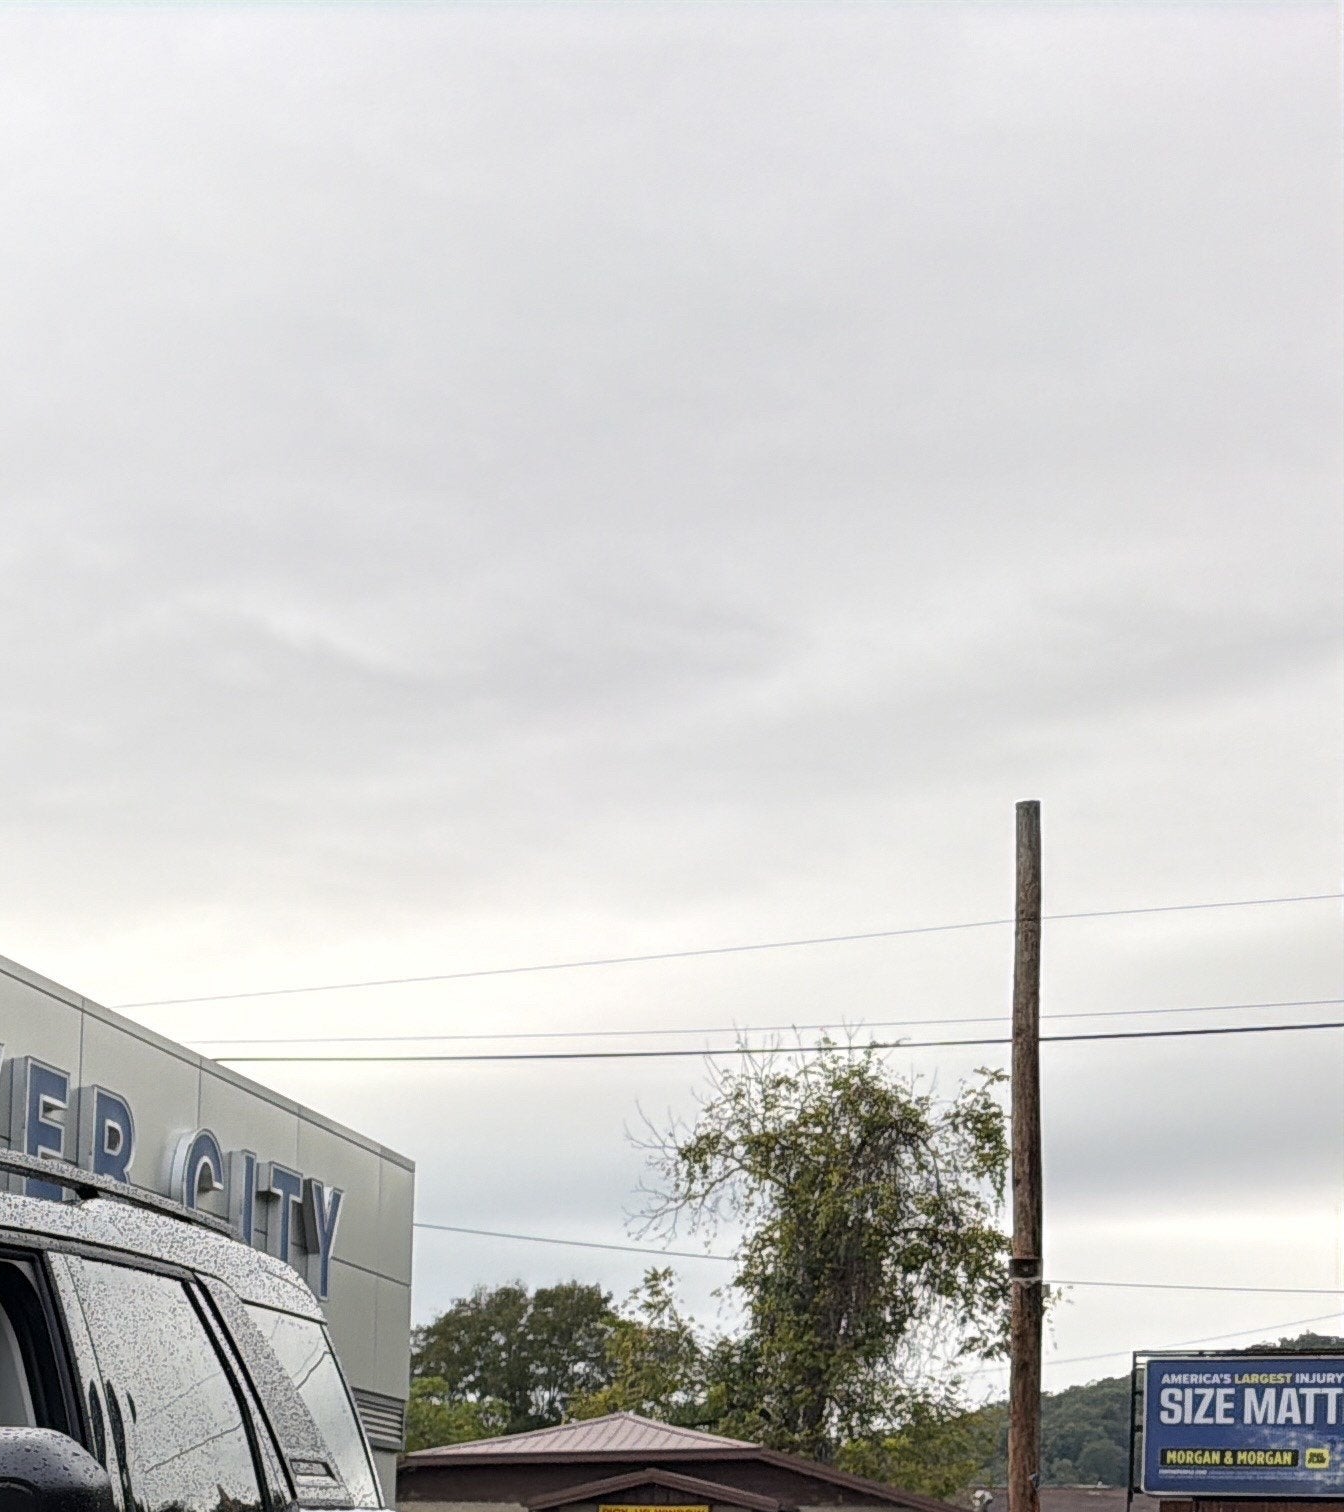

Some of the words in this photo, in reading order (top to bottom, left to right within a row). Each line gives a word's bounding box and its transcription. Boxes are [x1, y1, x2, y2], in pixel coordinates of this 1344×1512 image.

[167, 1127, 345, 1298] CITY
[1161, 1373, 1232, 1385] AMERICA'S
[1234, 1372, 1294, 1385] LARGEST
[1295, 1372, 1344, 1384] INJURY
[1159, 1387, 1236, 1425] SIZE
[1243, 1387, 1344, 1425] MATT
[1166, 1450, 1221, 1465] MORGAN
[1223, 1451, 1234, 1465] &
[1236, 1450, 1293, 1465] MORGAN
